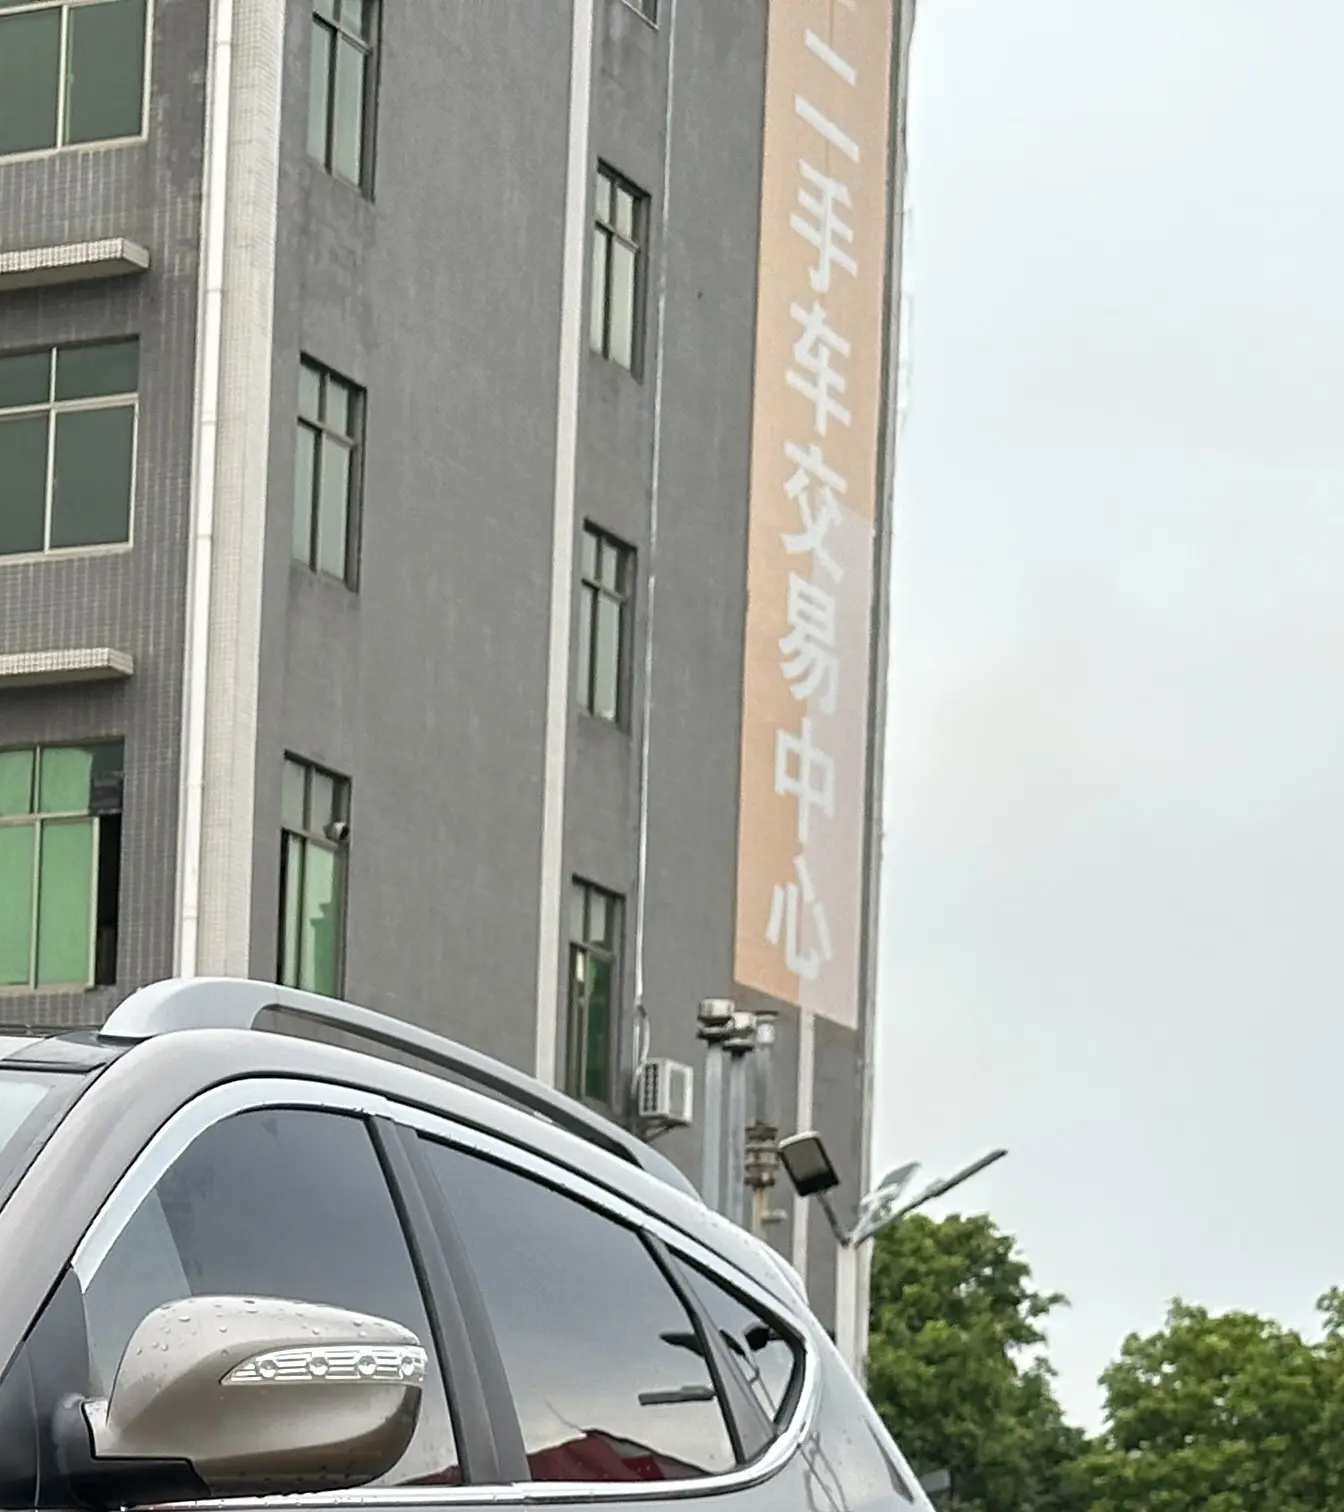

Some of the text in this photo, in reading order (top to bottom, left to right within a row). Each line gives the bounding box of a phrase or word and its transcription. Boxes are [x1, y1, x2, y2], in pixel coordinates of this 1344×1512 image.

[766, 0, 860, 981] 二手车交易中心
